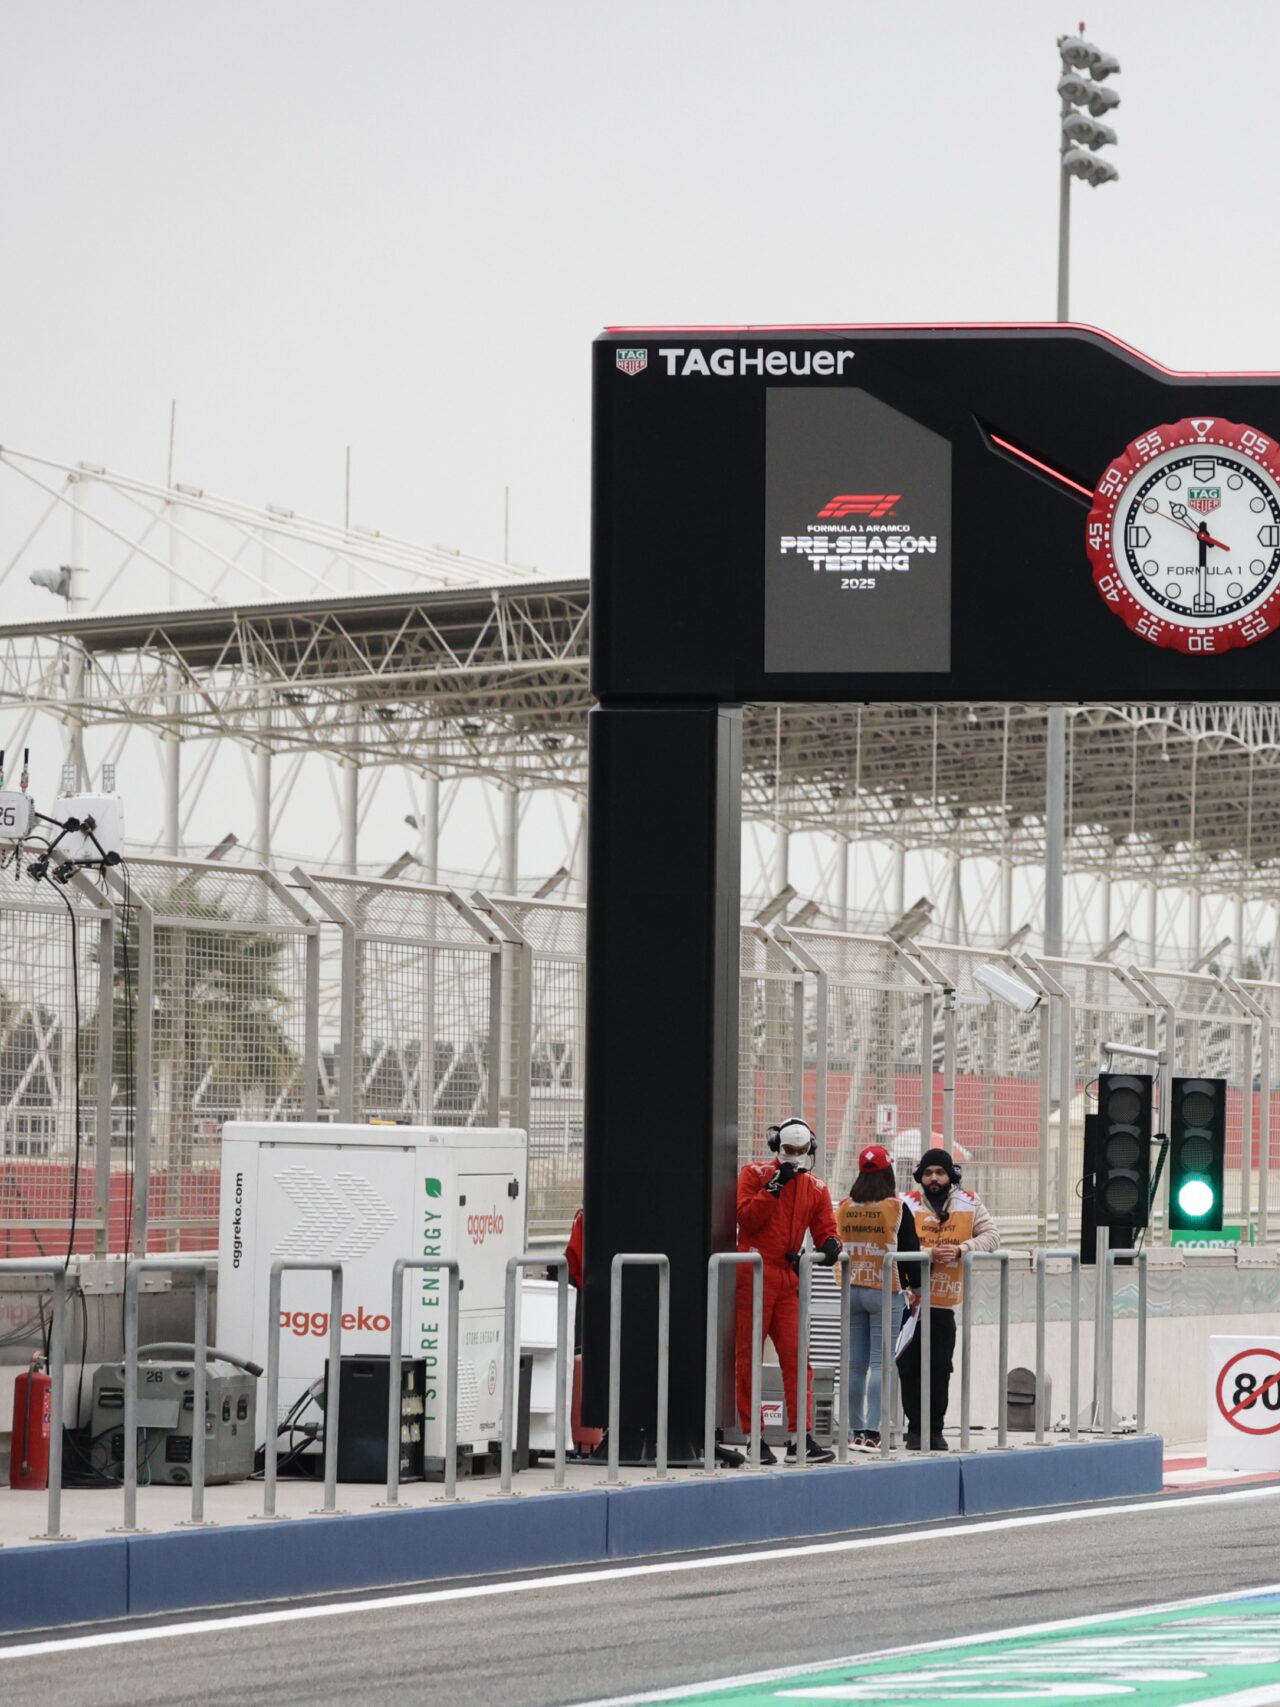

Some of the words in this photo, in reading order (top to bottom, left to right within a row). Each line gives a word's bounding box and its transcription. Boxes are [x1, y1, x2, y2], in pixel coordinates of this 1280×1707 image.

[619, 351, 645, 359] TAG
[1135, 431, 1162, 455] 55
[1240, 430, 1270, 454] 05
[1099, 468, 1122, 497] 50
[1190, 489, 1219, 498] TAG
[1190, 500, 1219, 513] HEUER
[807, 524, 857, 533] FORMULA
[859, 524, 865, 533] 1
[866, 524, 911, 533] ARAMCO
[1088, 523, 1103, 550] 45
[780, 535, 938, 554] PRE-SEASON
[807, 555, 911, 572] TESTING
[1237, 565, 1242, 575] 1
[840, 578, 877, 590] 2025
[1098, 576, 1120, 602] 40
[1135, 618, 1162, 642] 35
[1241, 616, 1270, 641] 25
[1188, 636, 1216, 651] 30
[0, 806, 16, 826] 6
[232, 1172, 244, 1269] aggreko.com
[467, 1204, 504, 1244] aggreko
[422, 1210, 442, 1307] ENERGY
[279, 1305, 392, 1338] aggeko
[146, 1370, 163, 1383] 26
